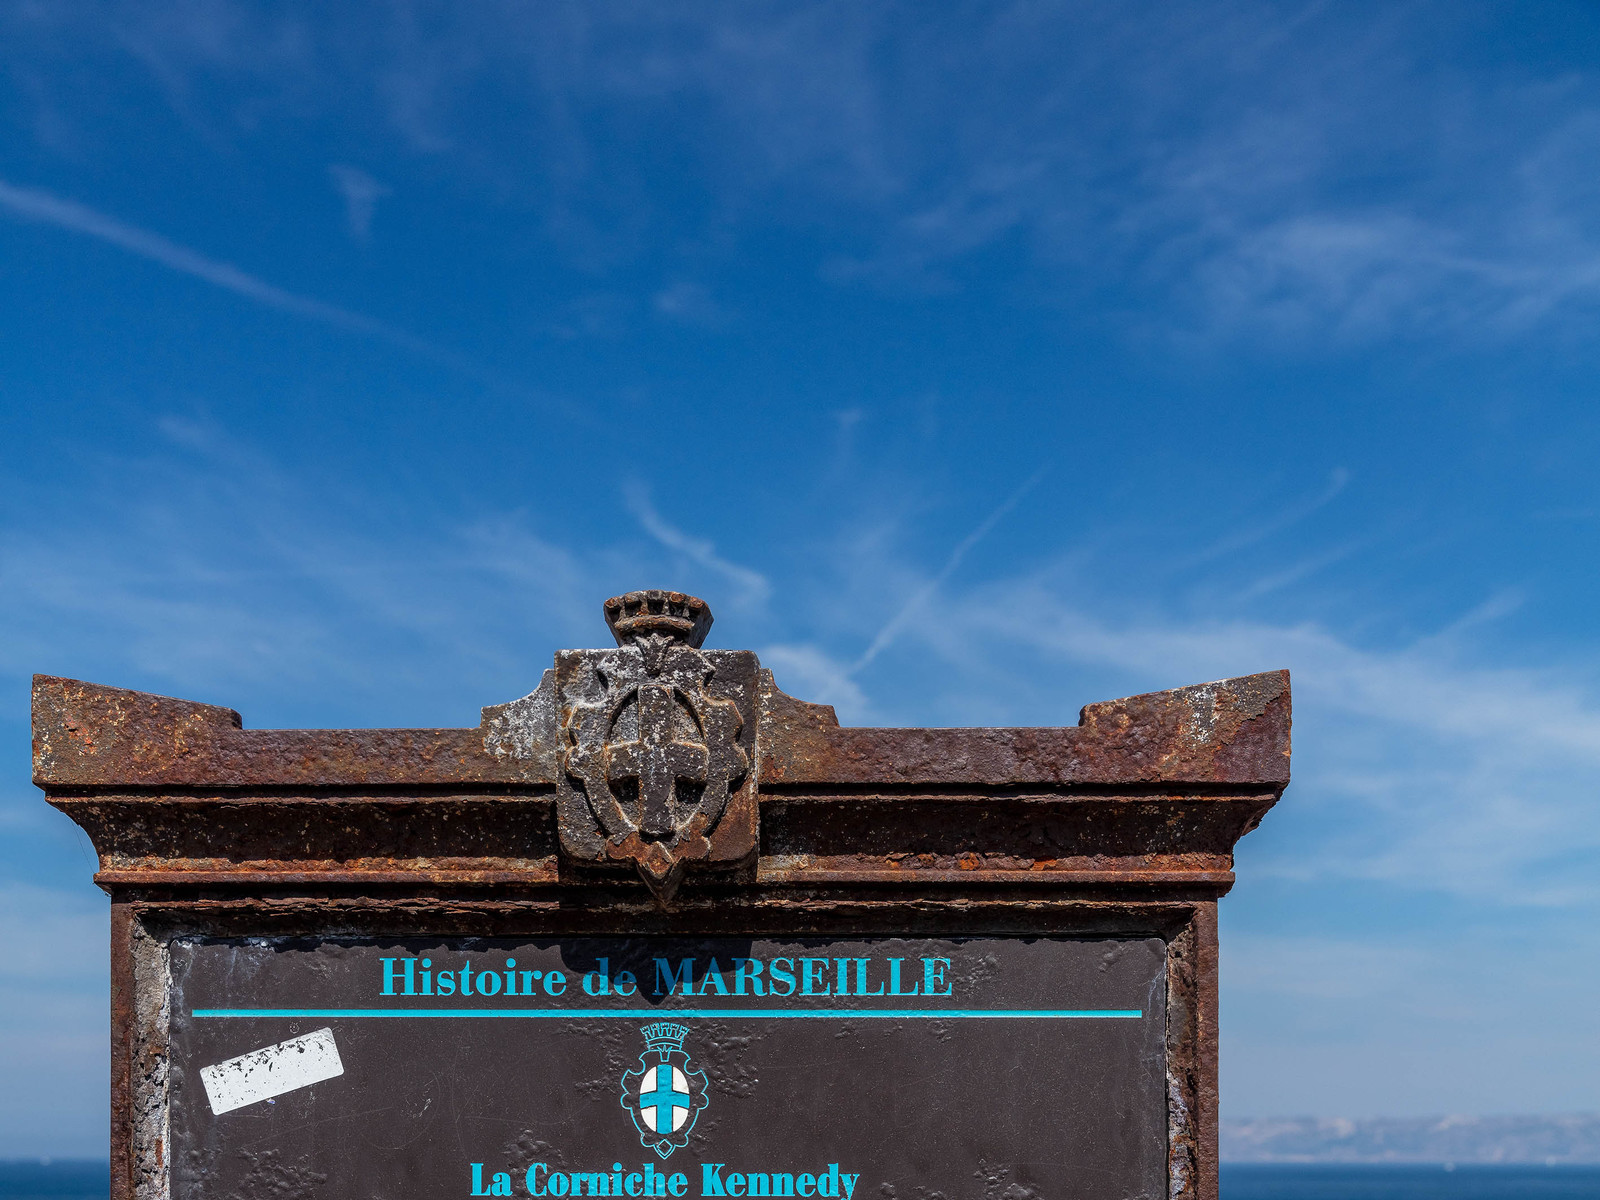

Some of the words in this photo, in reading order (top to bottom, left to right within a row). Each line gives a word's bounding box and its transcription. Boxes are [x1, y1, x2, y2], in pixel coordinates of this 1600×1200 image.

[378, 957, 567, 997] Histoire
[582, 956, 637, 997] de
[651, 956, 953, 997] MARSEILLE
[469, 1162, 513, 1197] La
[525, 1162, 689, 1198] Corniche
